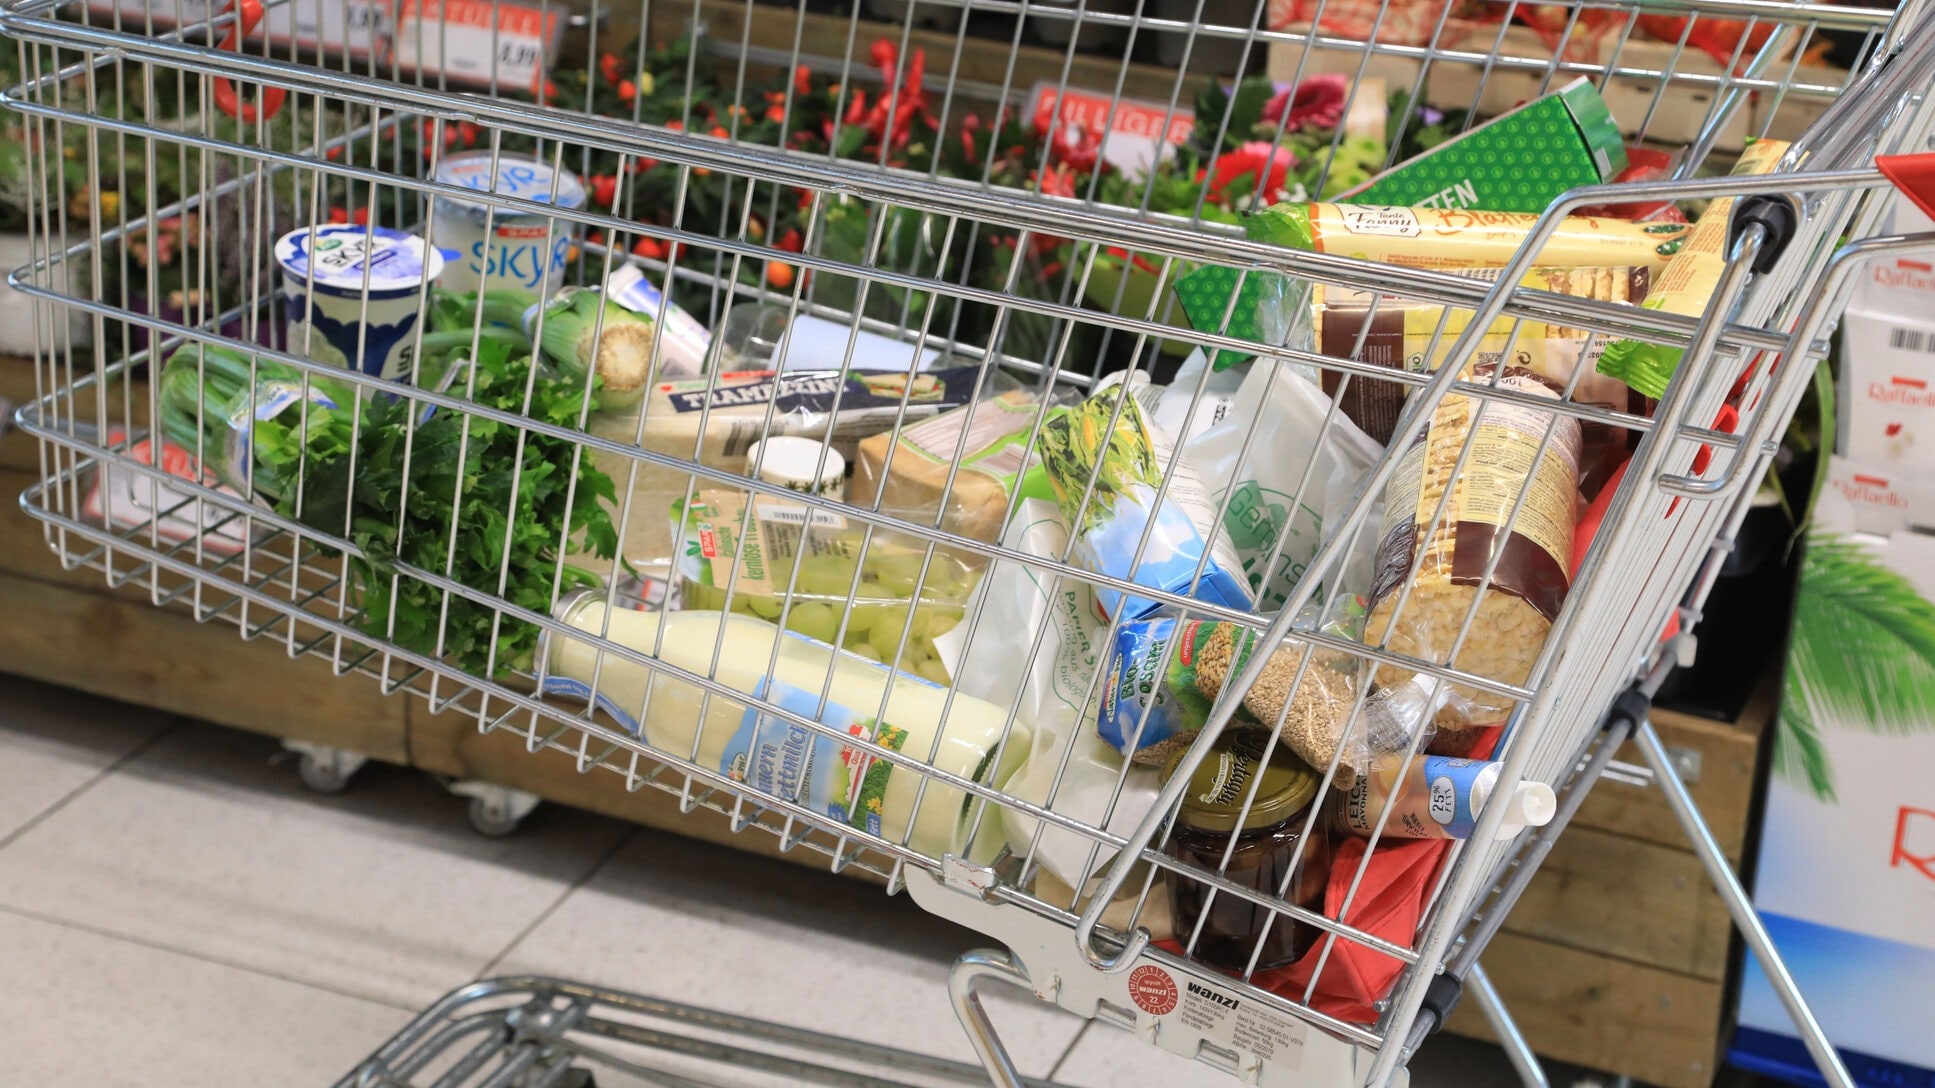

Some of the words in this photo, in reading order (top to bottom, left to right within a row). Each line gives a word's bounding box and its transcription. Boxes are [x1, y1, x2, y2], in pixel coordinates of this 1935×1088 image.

[1348, 211, 1414, 233] Fanny
[468, 235, 571, 289] SKYR
[1873, 264, 1935, 292] Raffael
[1868, 380, 1935, 407] Raffaell
[1065, 591, 1091, 654] PAPIER
[1120, 657, 1139, 701] Bio-
[757, 742, 778, 795] auern
[776, 723, 810, 800] ettmilch
[1350, 774, 1362, 830] LEIC
[1359, 776, 1371, 830] MAYONNA
[1431, 784, 1445, 813] 25%
[1443, 787, 1452, 813] FETT
[1138, 985, 1168, 996] wanzl
[1149, 995, 1160, 1004] 22
[1187, 981, 1241, 1011] wanzl
